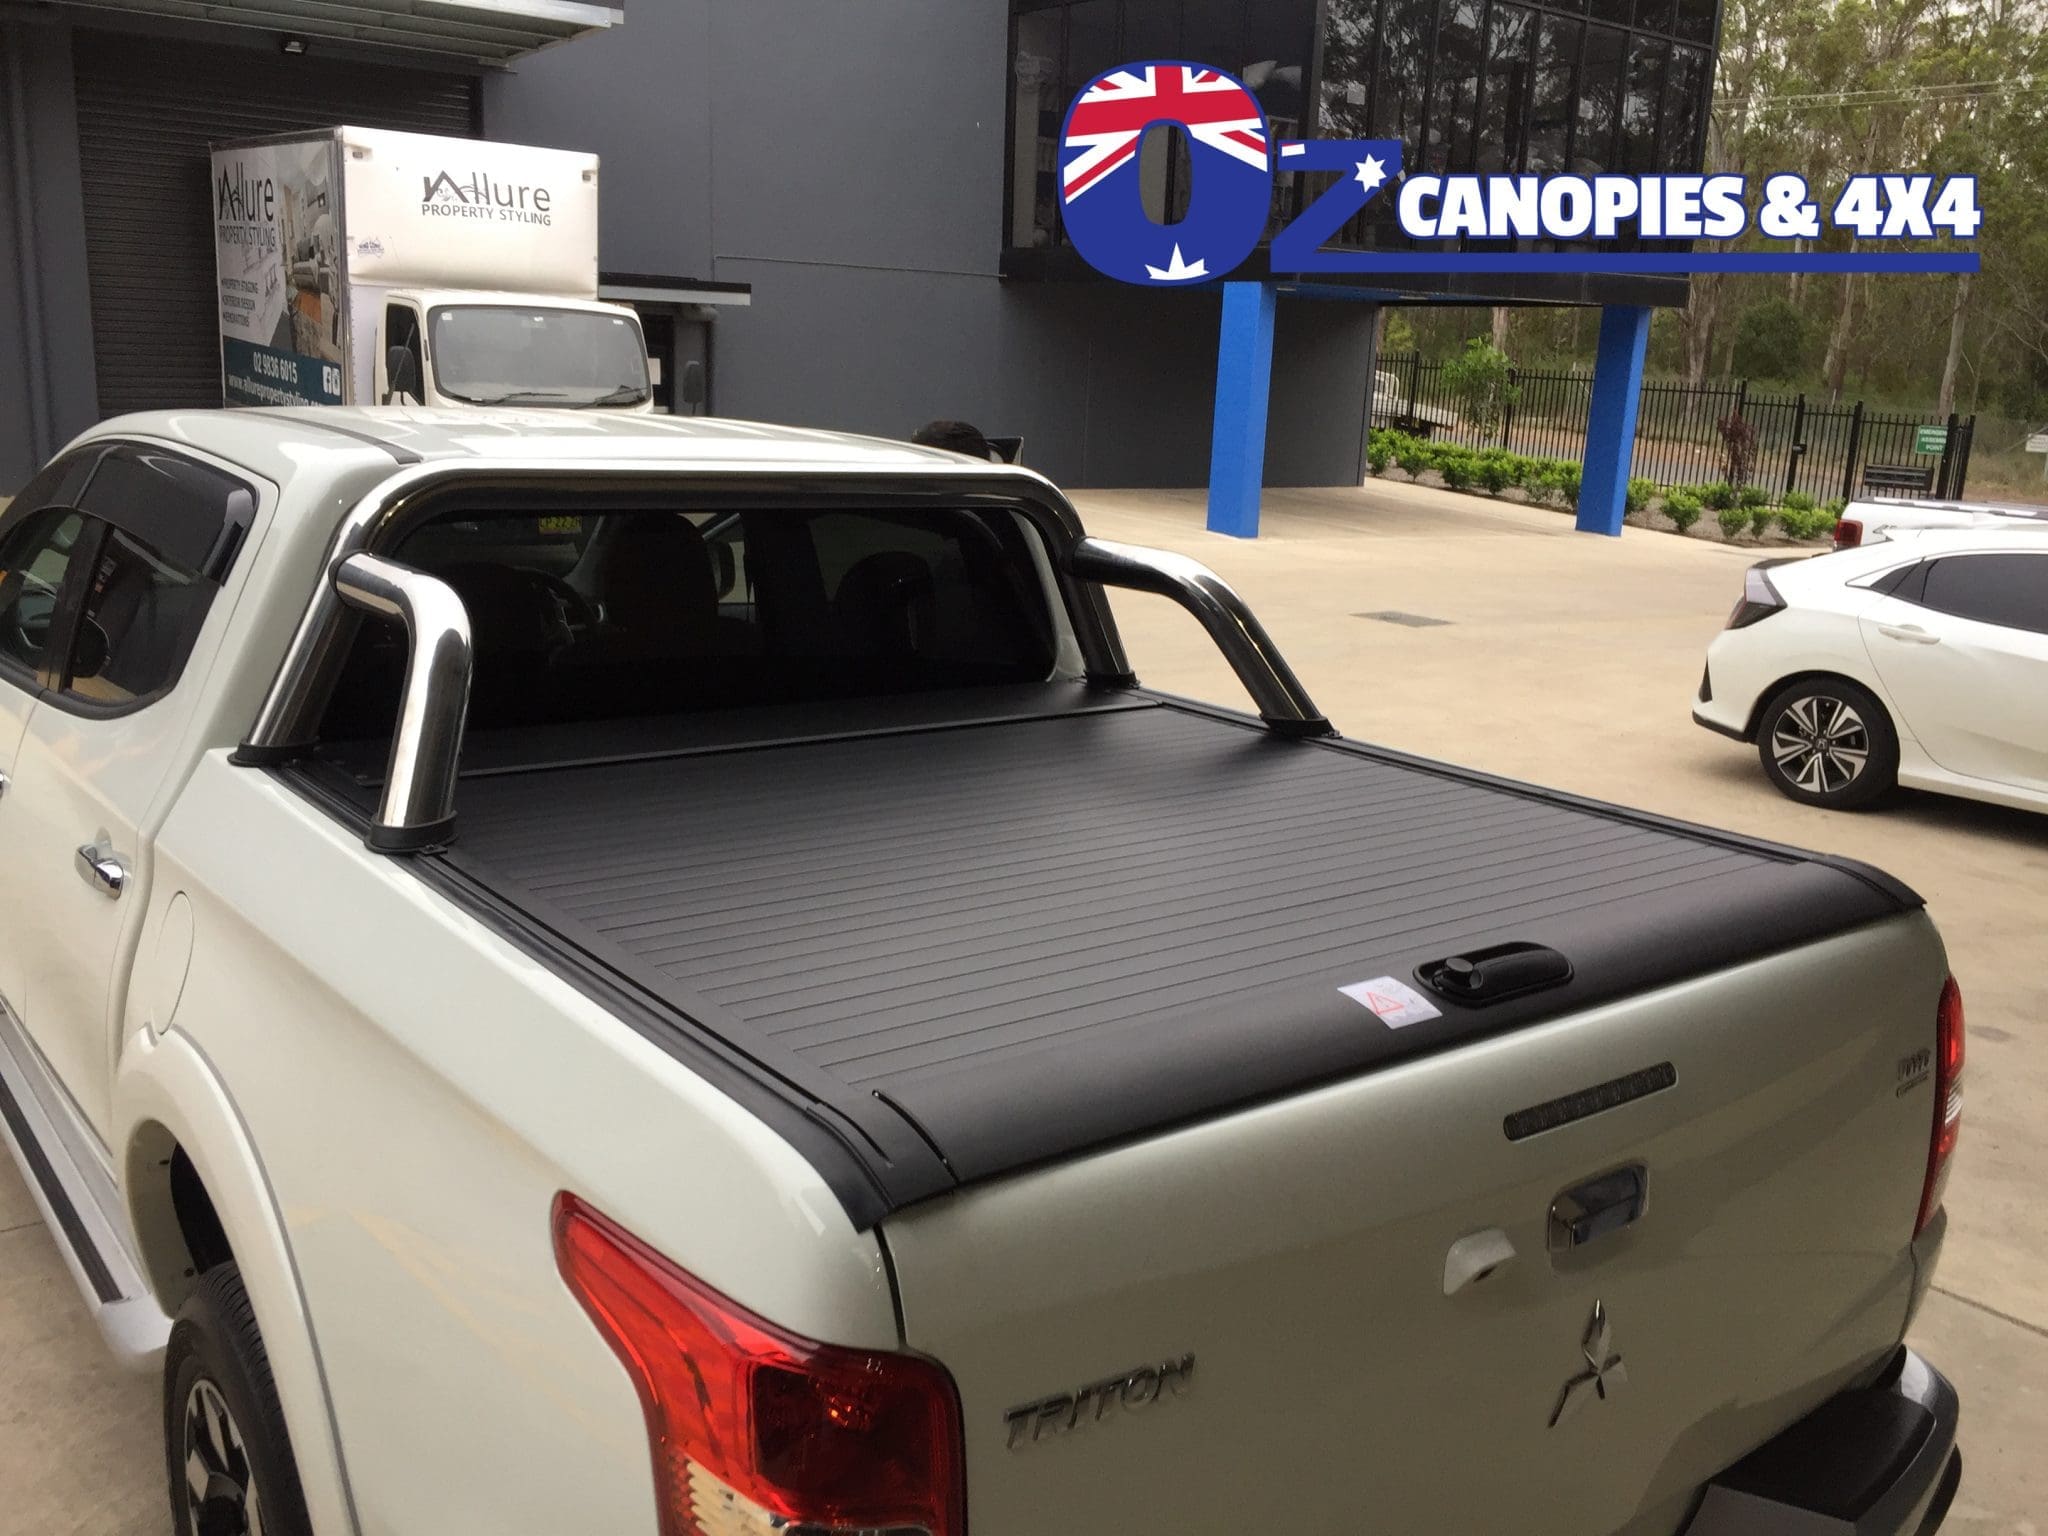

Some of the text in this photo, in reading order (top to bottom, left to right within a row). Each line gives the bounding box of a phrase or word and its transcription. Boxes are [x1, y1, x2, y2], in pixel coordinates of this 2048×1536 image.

[218, 162, 274, 222] Allure
[423, 170, 551, 212] Allure
[422, 204, 551, 226] PROPERTY STYLING
[218, 225, 276, 248] PROPERTY STYLING
[253, 351, 298, 385] 02 9836 6015
[1003, 1351, 1196, 1450] TRITON
